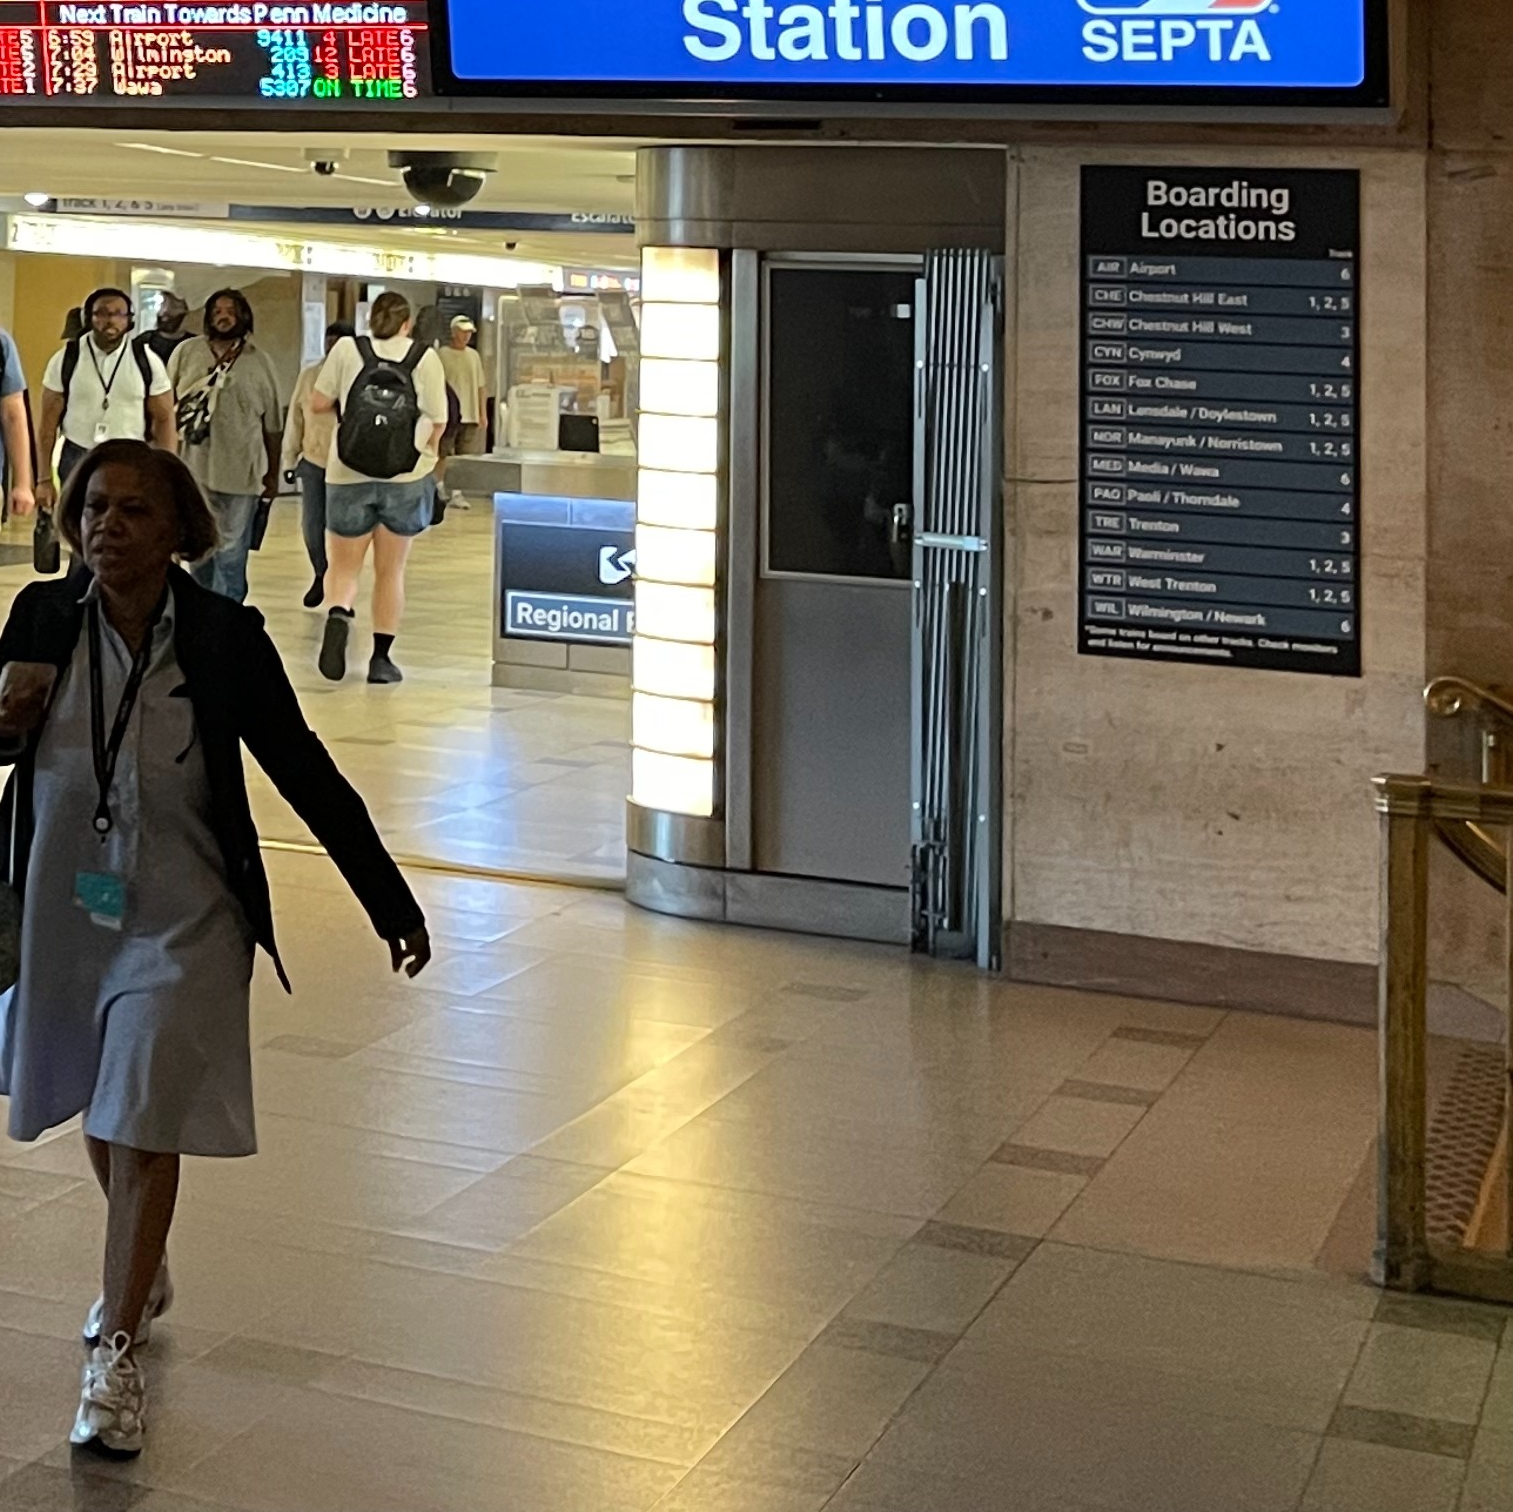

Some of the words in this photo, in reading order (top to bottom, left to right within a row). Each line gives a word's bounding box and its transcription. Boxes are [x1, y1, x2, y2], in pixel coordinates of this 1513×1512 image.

[59, 4, 107, 24] Next
[109, 4, 161, 24] Train
[163, 4, 251, 24] Towards
[254, 4, 309, 24] Penn
[312, 2, 407, 24] Medicine
[1081, 19, 1272, 62] SEPTA
[1146, 180, 1290, 215] Boarding
[1141, 212, 1296, 240] Locations
[1097, 262, 1120, 273] AIR
[1130, 263, 1176, 275] Airport
[1341, 269, 1350, 280] 6
[1129, 290, 1189, 304] Chestnut
[1193, 293, 1214, 304] Hill
[1219, 294, 1247, 306] East
[1341, 298, 1349, 310] 5
[1129, 319, 1188, 332] Chestnut
[1193, 321, 1214, 334] Hill
[1219, 323, 1252, 335] West
[1341, 327, 1349, 338] 3
[1094, 348, 1121, 358] CYN
[1129, 348, 1181, 362] Cynwyd
[1341, 356, 1350, 367] 4
[1095, 376, 1120, 386] FOX
[1129, 376, 1151, 387] Fox
[1155, 377, 1196, 390] Chase
[1341, 386, 1350, 397] 5
[1095, 404, 1121, 415] LAN
[1129, 404, 1186, 418] Lansdale
[1199, 408, 1276, 424] Doylestown
[1341, 415, 1349, 426] 5
[1094, 432, 1121, 443] NOR
[1129, 433, 1196, 449] Manayunk
[1209, 437, 1282, 452] Norristown
[1341, 444, 1350, 455] 5
[1094, 460, 1121, 471] MED
[1129, 461, 1168, 474] Media
[1181, 465, 1219, 478] Wawa
[1341, 473, 1350, 485] 6
[1094, 488, 1120, 499] PAO
[1128, 490, 1161, 502] Paoli
[1173, 492, 1240, 507] Thorndale
[1341, 503, 1350, 515] 4
[1096, 517, 1119, 528] TRE
[1129, 518, 1179, 532] Trenton
[1341, 533, 1349, 543] 3
[1093, 546, 1121, 557] WAR
[1129, 547, 1204, 563] Warminster
[1341, 561, 1350, 573] 5
[1092, 574, 1121, 586] WTR
[1129, 576, 1161, 589] West
[1166, 578, 1216, 592] Trenton
[1341, 591, 1350, 602] 5
[517, 602, 619, 632] Regional
[1095, 603, 1118, 615] WIL
[1128, 605, 1202, 622] Wilmington
[1215, 612, 1265, 626] Newark
[1341, 621, 1350, 633] 6
